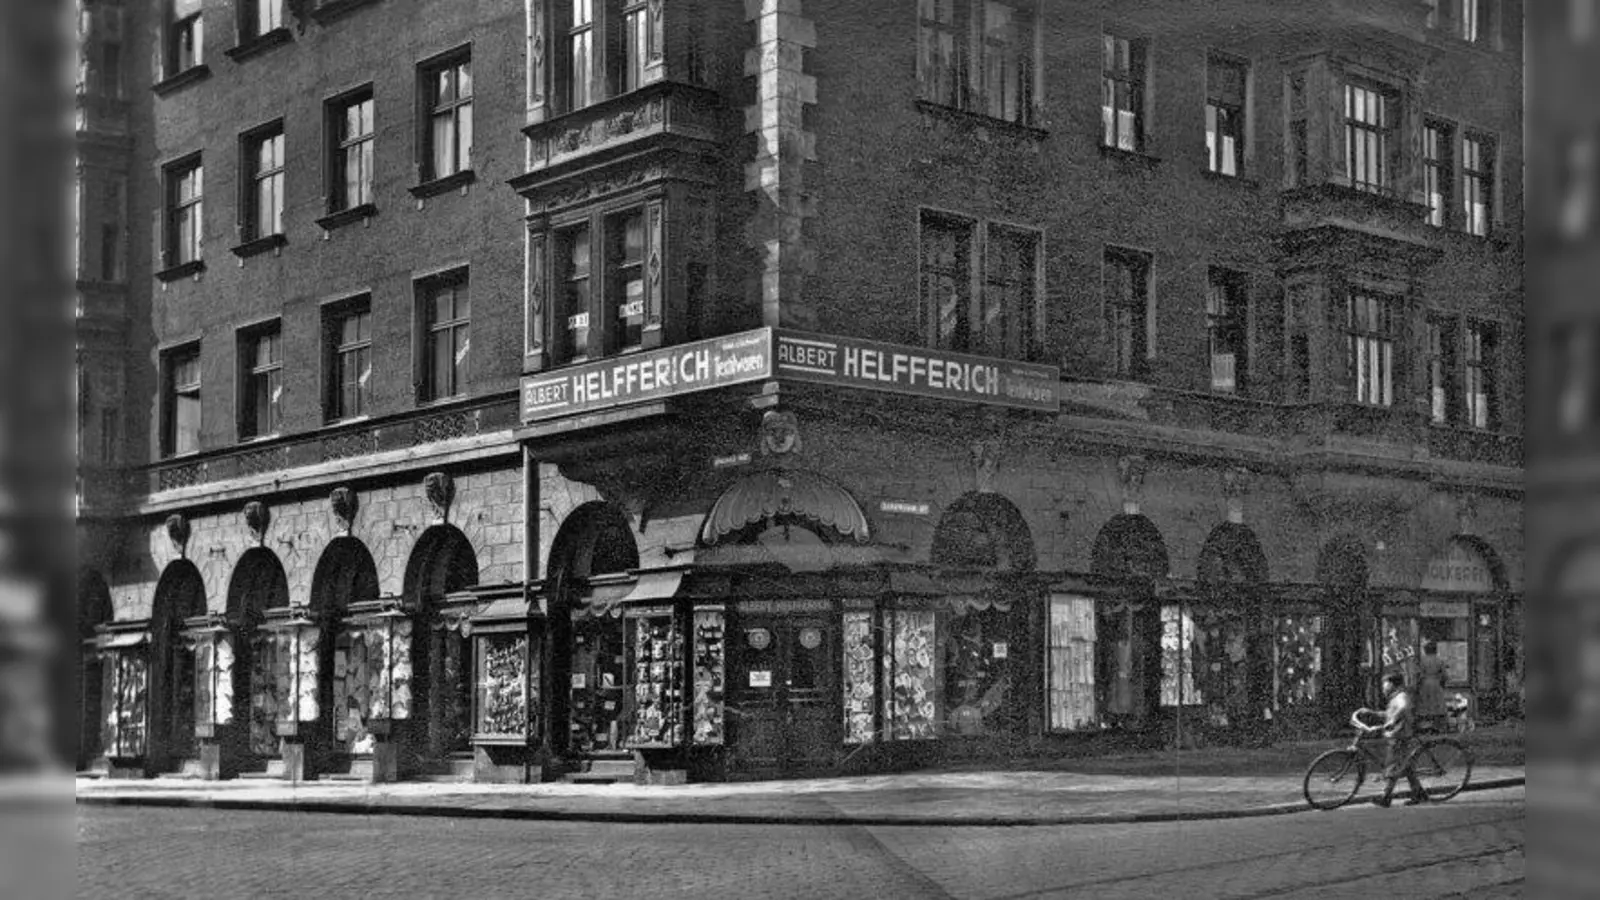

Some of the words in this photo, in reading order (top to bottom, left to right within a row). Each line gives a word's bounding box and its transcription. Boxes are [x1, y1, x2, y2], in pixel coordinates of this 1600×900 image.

[525, 383, 569, 405] ALBERT
[573, 350, 709, 403] HELFFERICH
[778, 344, 837, 368] ALBERT
[844, 347, 999, 395] HELFFERICH
